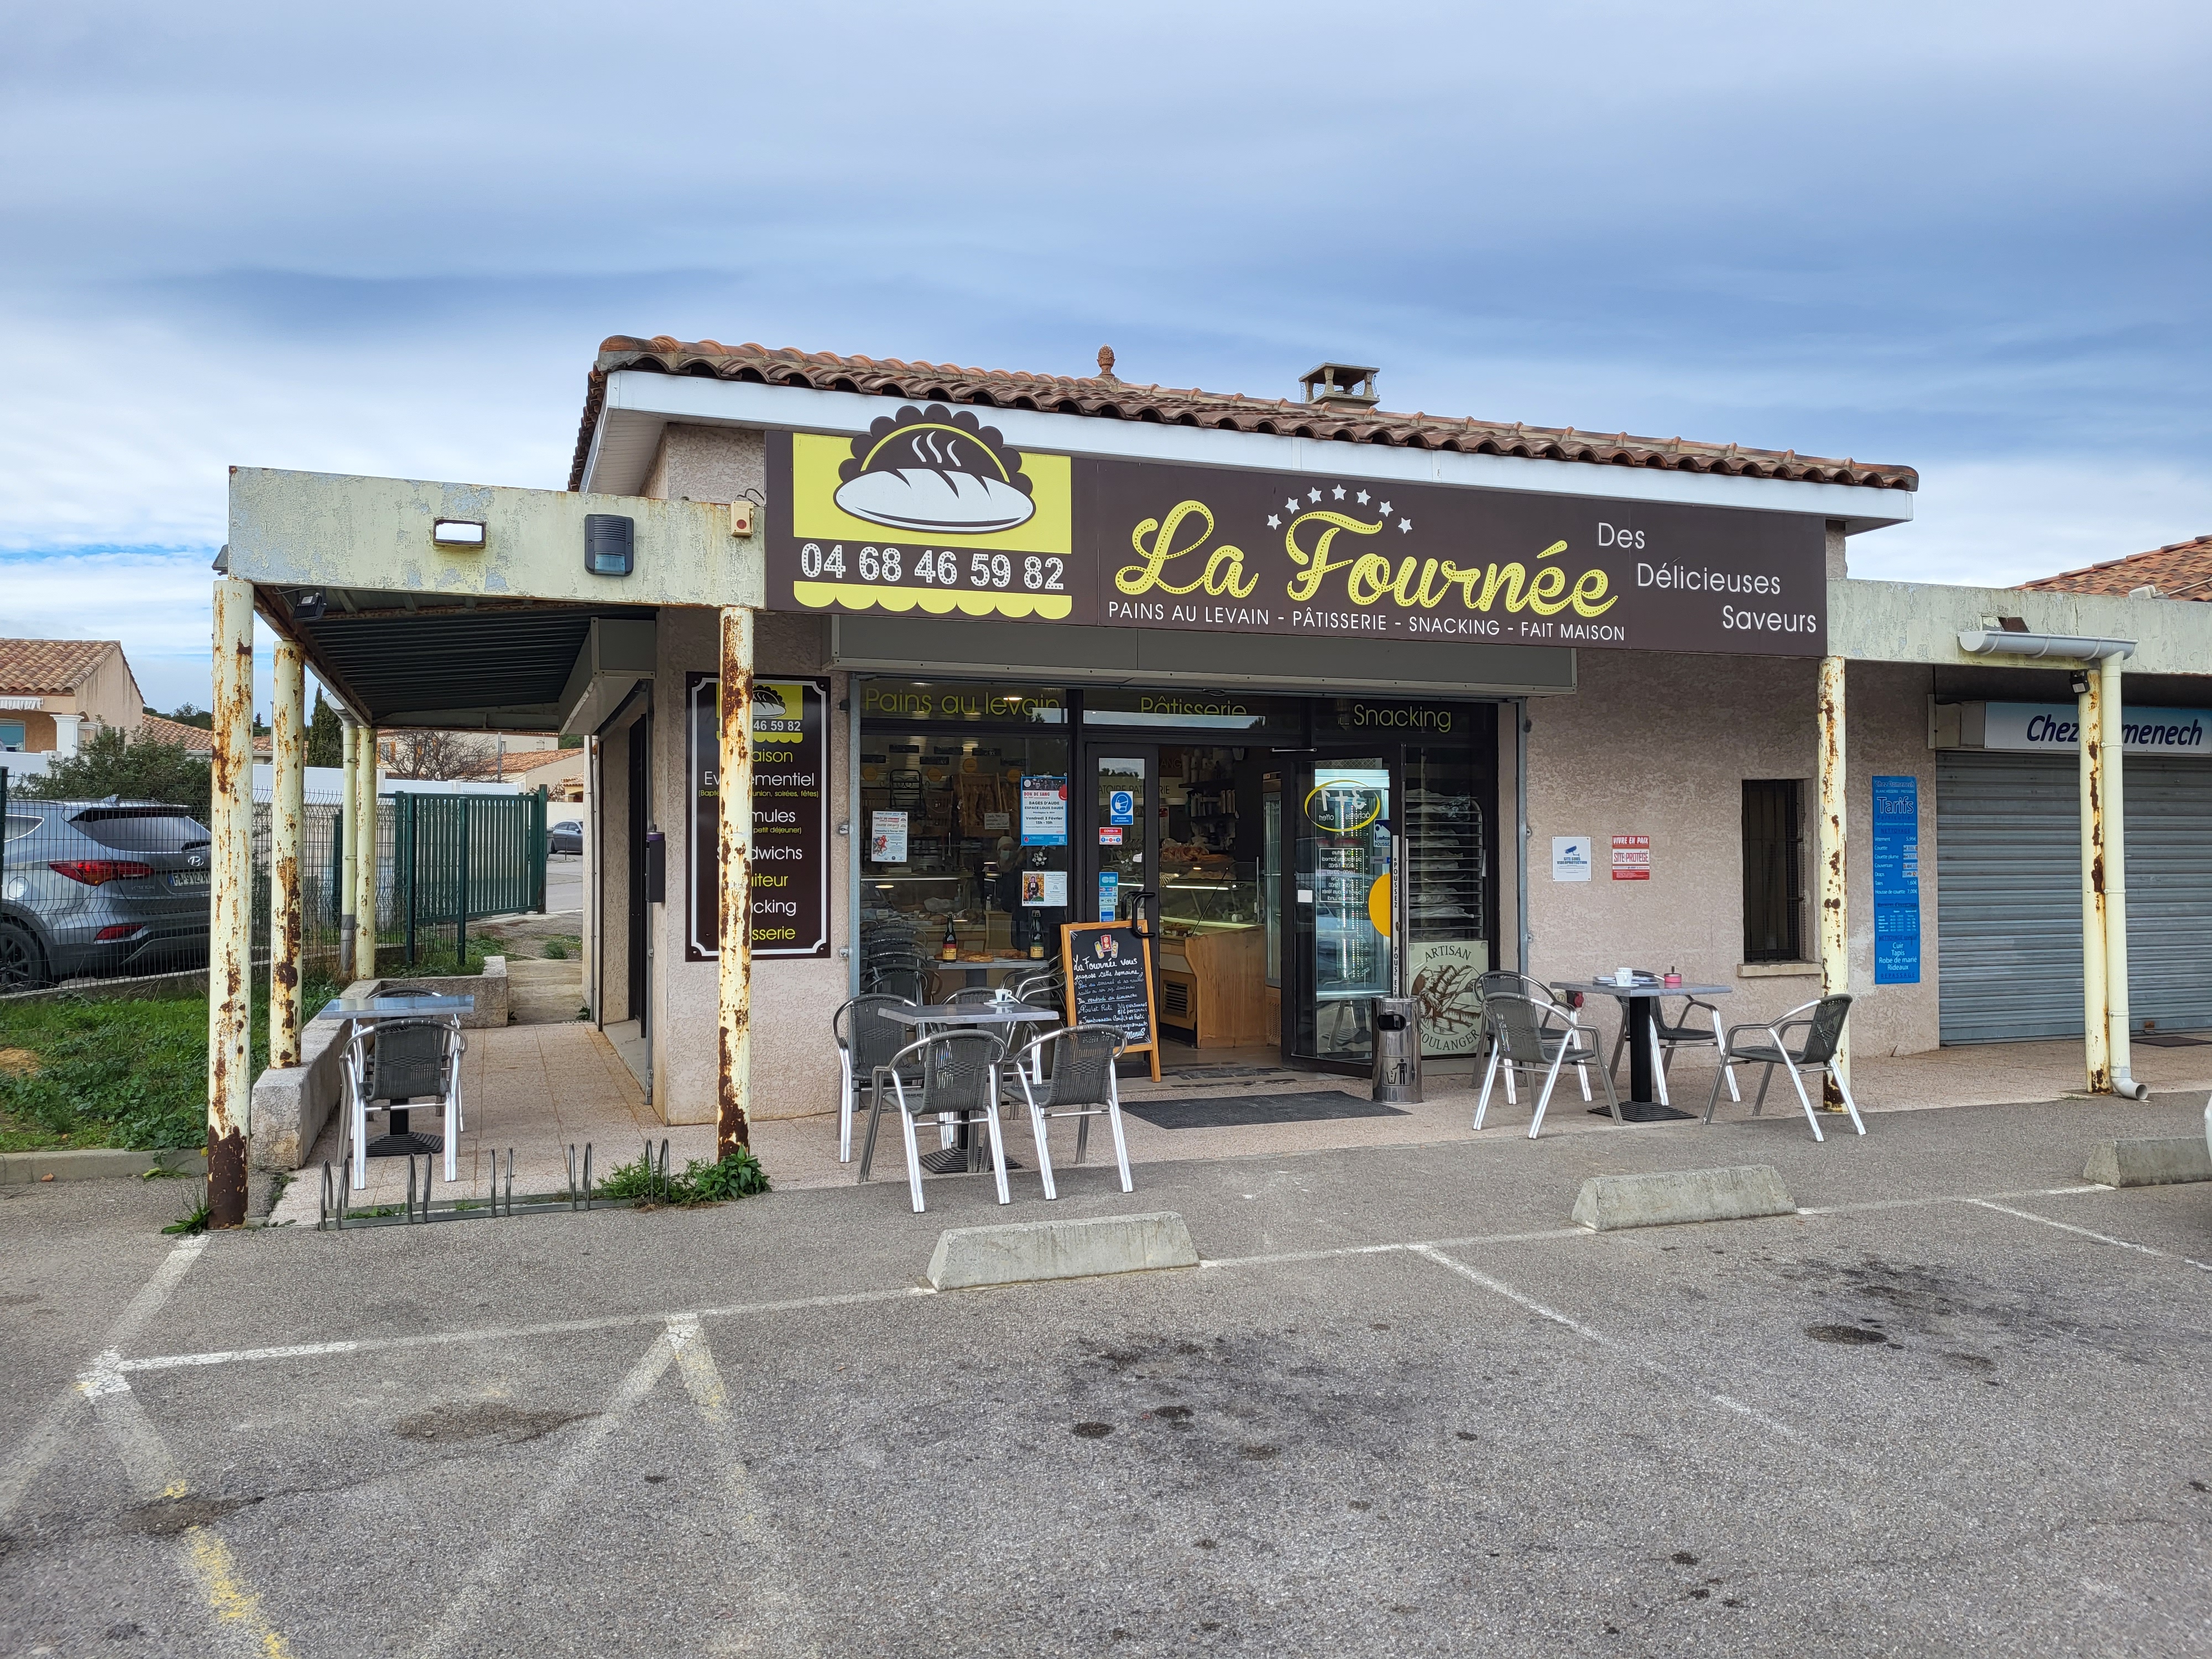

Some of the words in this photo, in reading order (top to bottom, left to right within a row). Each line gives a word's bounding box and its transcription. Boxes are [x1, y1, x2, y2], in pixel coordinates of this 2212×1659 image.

[1598, 522, 1646, 549] Des
[801, 543, 846, 578] 04
[859, 546, 902, 581] 68
[914, 550, 957, 585] 46
[970, 554, 1011, 587] 59
[1024, 557, 1064, 590] 82
[1115, 500, 1259, 598] La
[1286, 511, 1619, 617] Fournée
[1637, 561, 1781, 595] Délicieuses
[1109, 601, 1164, 620] PAINS
[1171, 604, 1197, 622] AU
[1206, 607, 1270, 625] LEVAIN
[1293, 607, 1386, 631] PÂTISSERIE
[1409, 616, 1500, 635] SNACKING
[1521, 623, 1553, 639] FAIT
[1560, 624, 1625, 641] MAISON
[1722, 605, 1817, 633] Saveurs
[864, 687, 932, 713] Pains
[941, 695, 975, 715] au
[985, 691, 1060, 716] levain
[1140, 696, 1248, 716] Pâtisserie
[753, 720, 767, 731] 46
[770, 721, 784, 731] 59
[787, 721, 801, 731] 82
[1354, 704, 1452, 733] Snacking
[2027, 714, 2079, 742] Chez
[2122, 719, 2203, 745] menech
[753, 748, 793, 762] aison
[705, 771, 815, 786] Evmentiel
[801, 790, 819, 798] fêtes)
[1876, 796, 1914, 814] Tarifs
[752, 808, 796, 822] mules
[717, 846, 802, 860] dwichs
[1614, 853, 1624, 862] SITE
[1626, 851, 1648, 862] PROTÉGÉ
[751, 873, 789, 887] iteur
[751, 899, 796, 916] cking
[752, 926, 796, 940] sserie
[1073, 954, 1084, 971] La
[1082, 956, 1118, 970] Fournée
[1425, 945, 1472, 963] ARTISAN
[1074, 973, 1097, 982] propose
[1080, 1004, 1099, 1013] Poulet
[1082, 1016, 1112, 1024] Jambonneau
